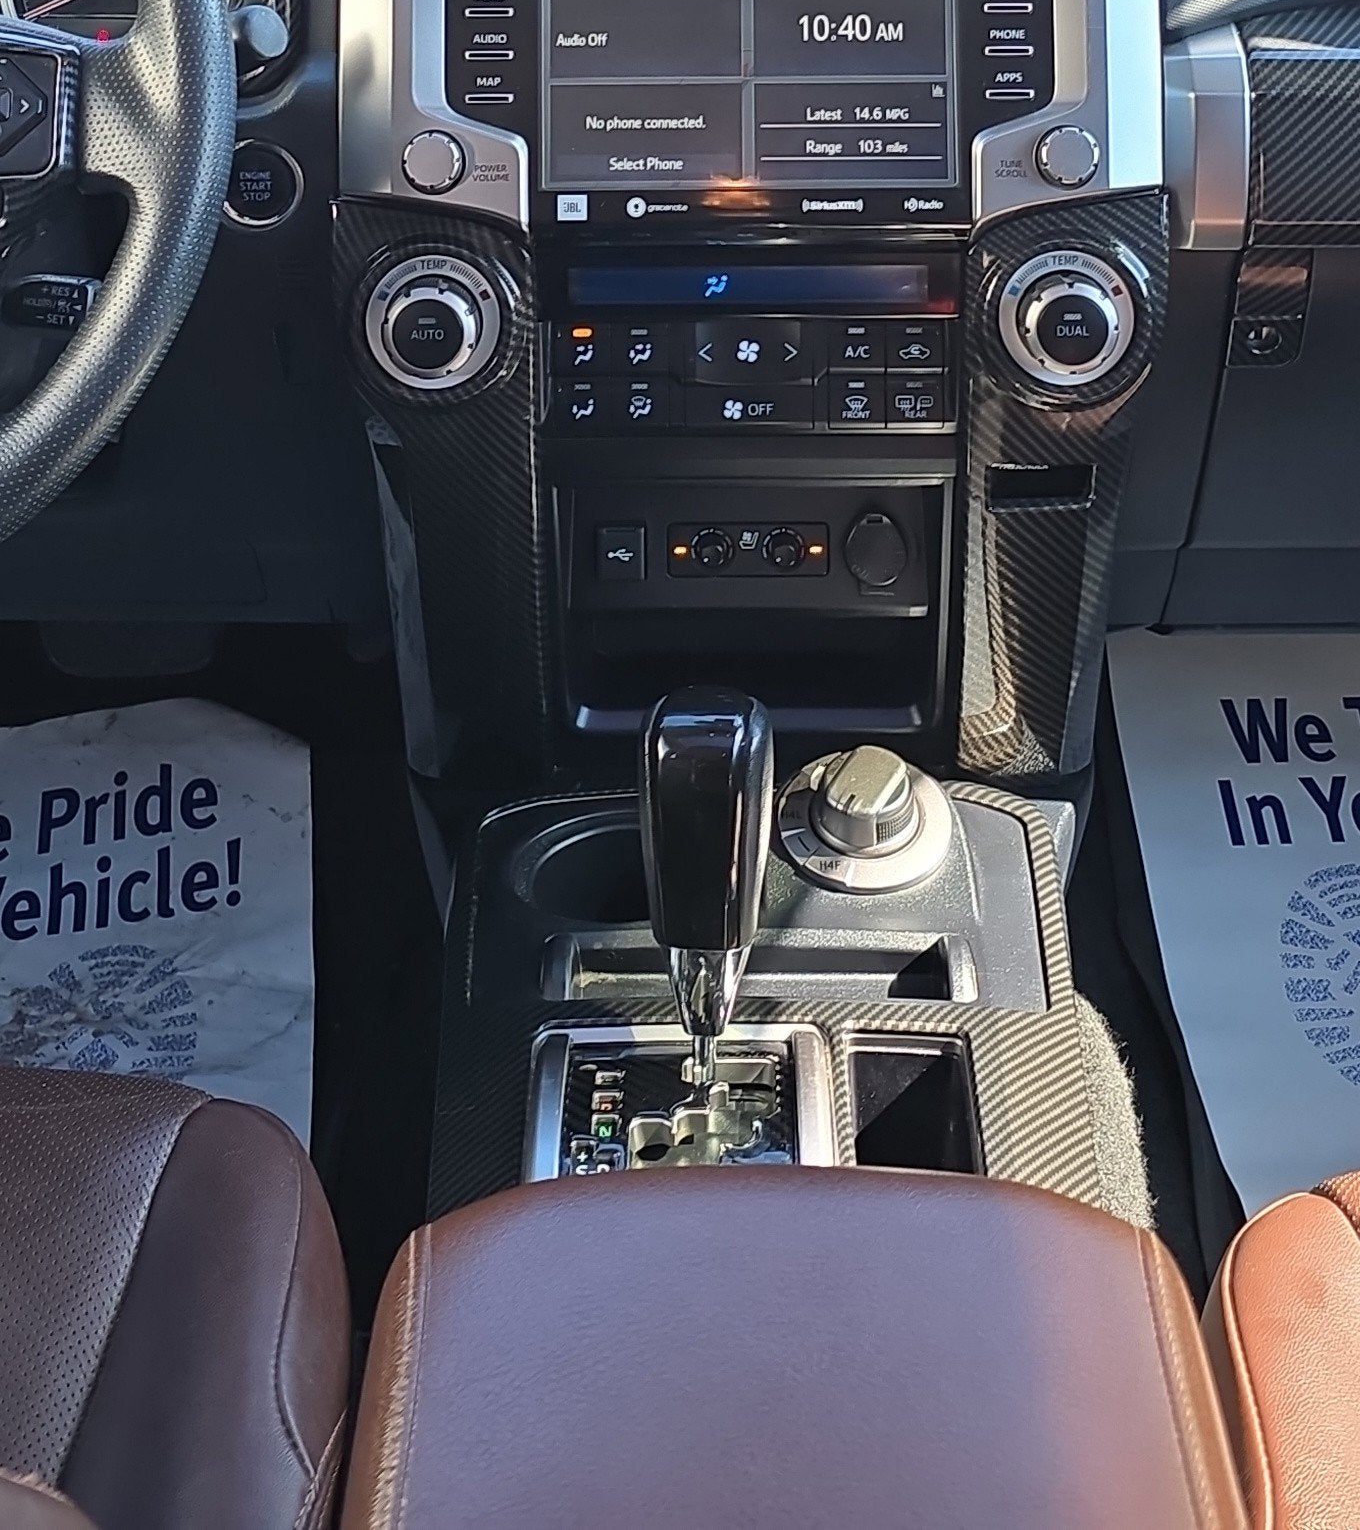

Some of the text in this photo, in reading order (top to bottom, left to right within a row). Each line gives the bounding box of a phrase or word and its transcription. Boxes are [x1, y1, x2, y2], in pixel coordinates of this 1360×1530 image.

[798, 14, 903, 42] 10:40 AM
[472, 34, 507, 43] AUDIO
[555, 33, 608, 47] Audio Off
[990, 29, 1026, 40] PHONE
[476, 77, 501, 87] MAP
[995, 72, 1023, 83] APPS
[806, 106, 910, 121] Latest 14.6 MPG
[585, 115, 707, 132] No phone connected.
[806, 139, 909, 155] Range 103 miles
[474, 164, 507, 173] POWER
[609, 156, 683, 171] Select Phone
[1000, 160, 1023, 169] TUNE
[240, 171, 271, 180] ENGINE
[473, 173, 510, 182] VOLUME
[995, 169, 1028, 179] SCROLL
[239, 181, 272, 191] START
[243, 192, 271, 201] STOP
[563, 202, 582, 213] JBL
[918, 200, 944, 210] Radio
[420, 259, 448, 271] TEMP
[1051, 255, 1079, 267] TEMP
[46, 313, 66, 325] SET
[410, 329, 444, 341] AUTO
[1056, 325, 1089, 337] DUAL
[844, 345, 870, 360] A/C
[748, 403, 774, 416] OFF
[842, 410, 870, 419] FRONT
[905, 410, 928, 419] REAR
[1221, 696, 1336, 764] We
[38, 763, 218, 855] Pride
[1218, 778, 1292, 847] In
[819, 860, 841, 870] H4F
